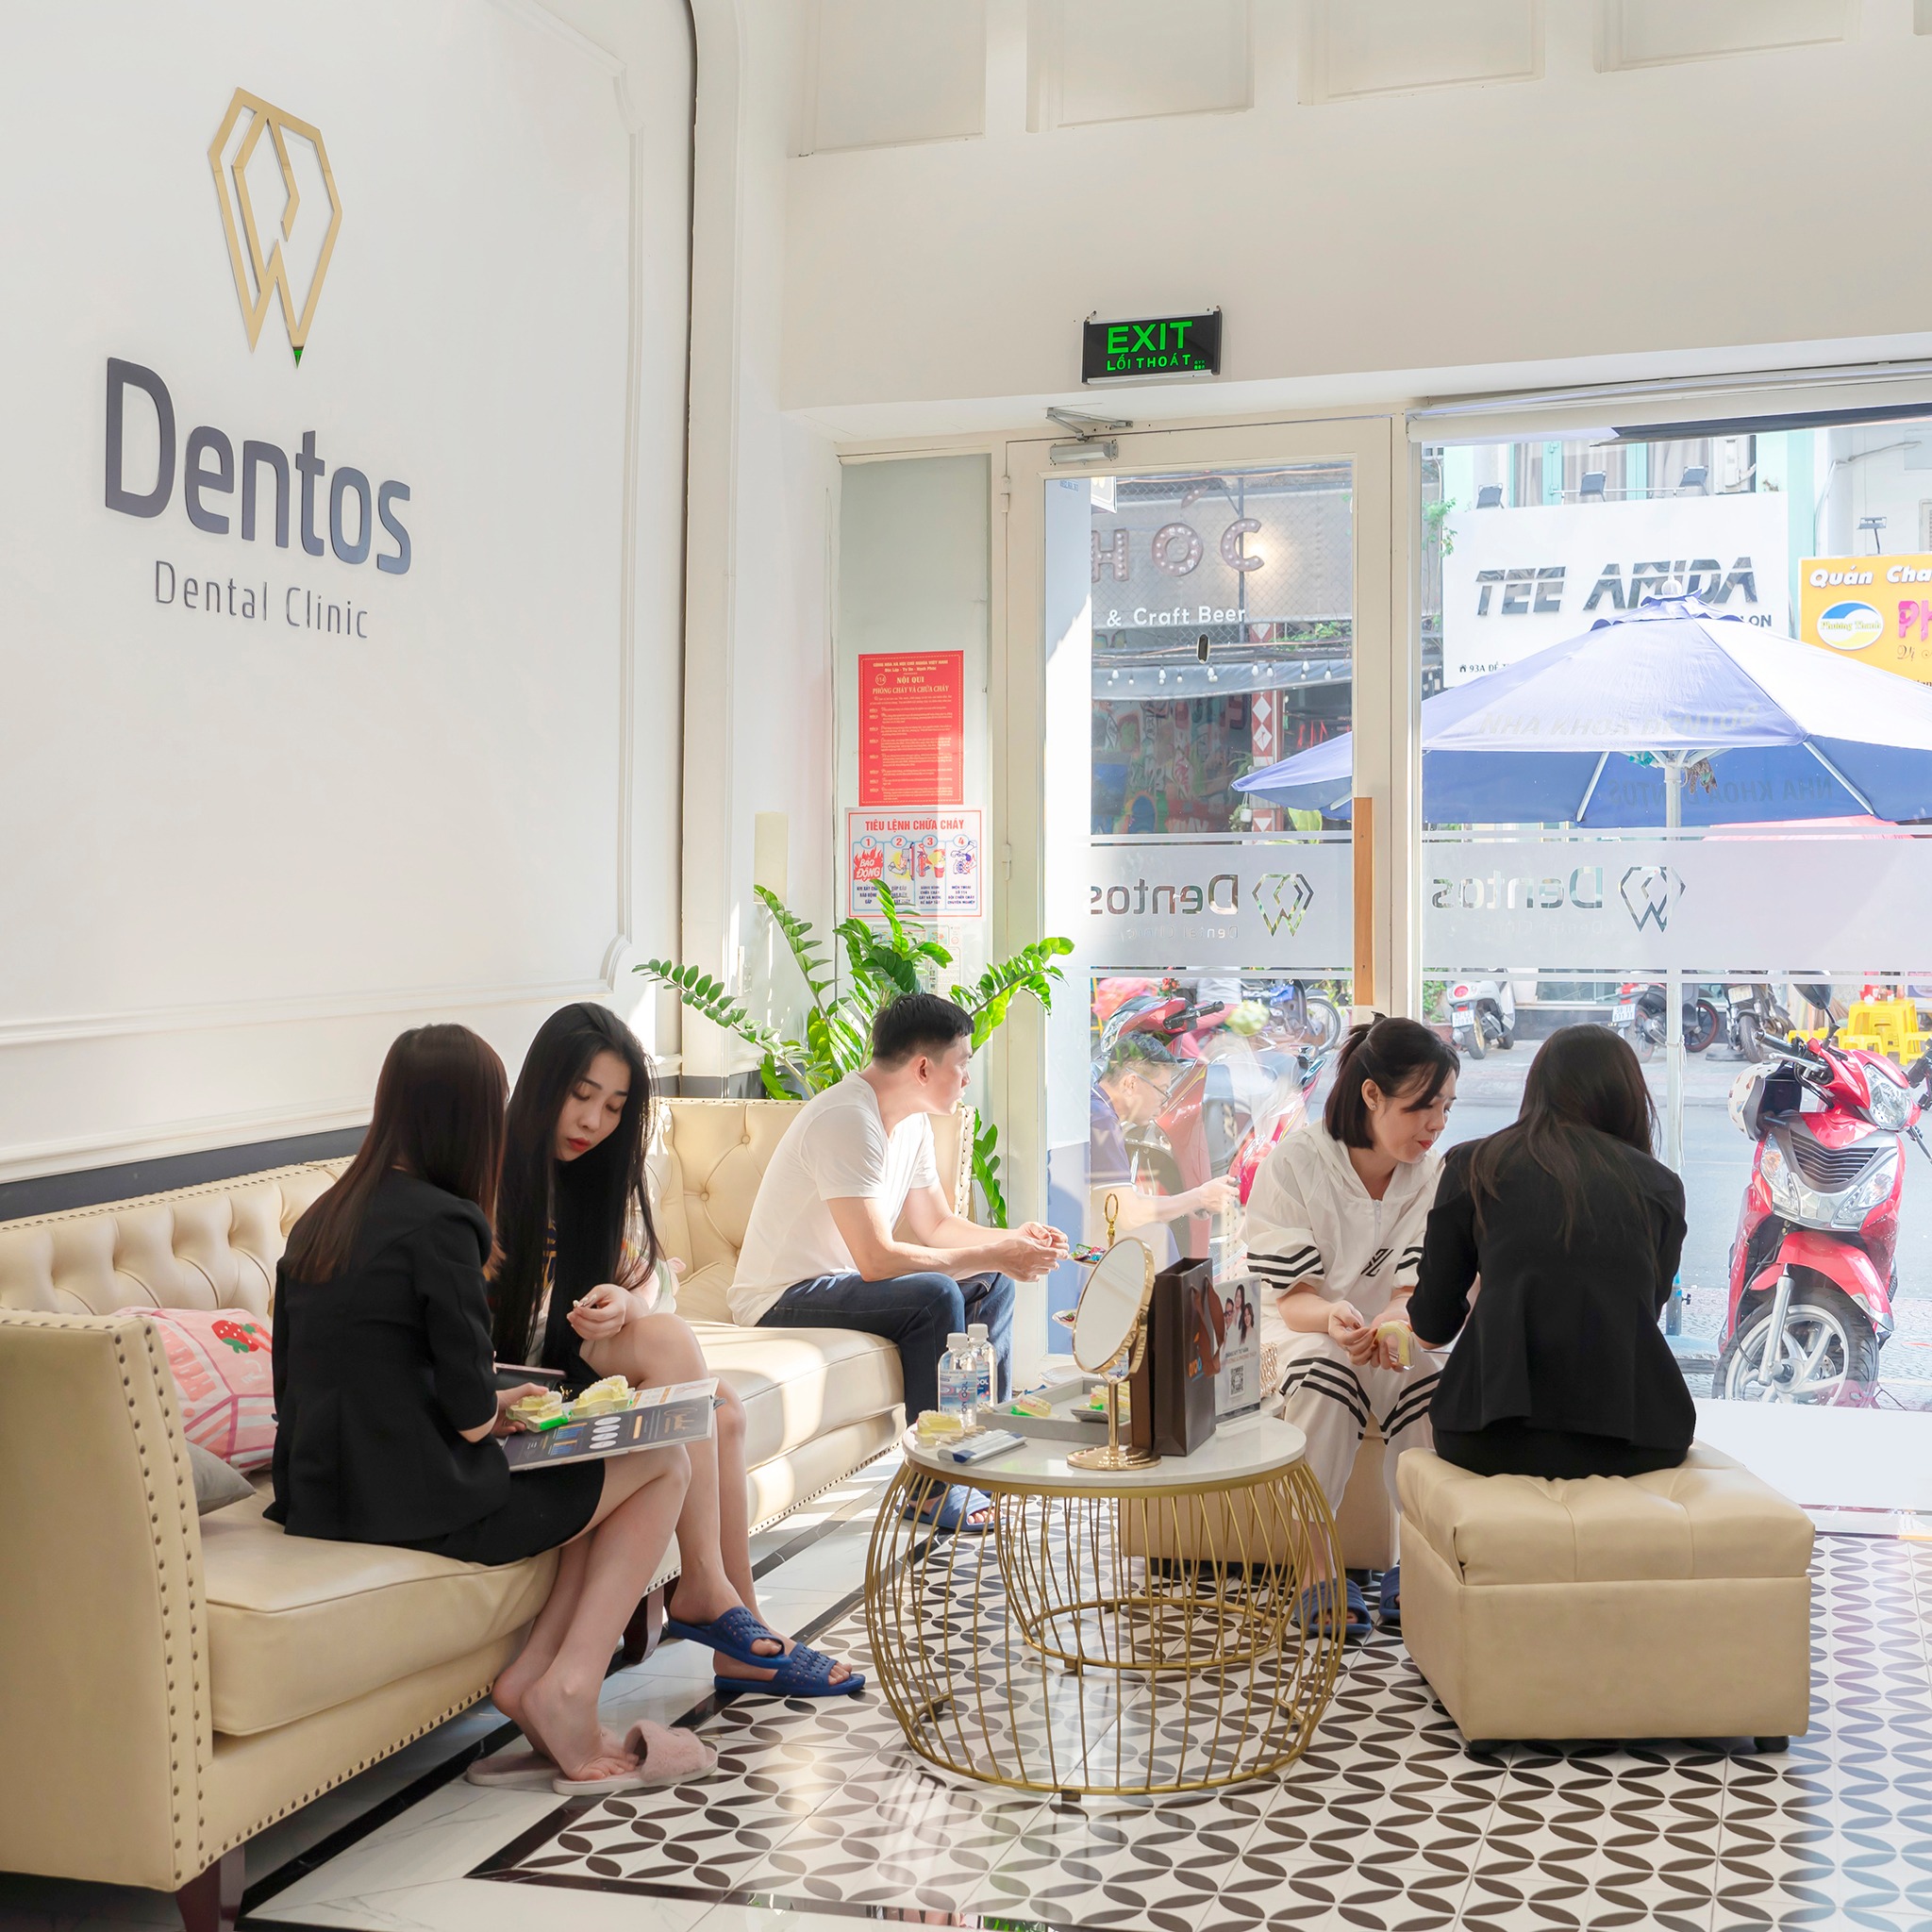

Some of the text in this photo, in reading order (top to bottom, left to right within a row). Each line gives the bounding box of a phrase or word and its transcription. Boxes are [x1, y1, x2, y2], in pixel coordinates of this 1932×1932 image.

[1108, 321, 1192, 354] EXIT
[1107, 353, 1131, 371] LỐI
[1136, 352, 1191, 369] THOÁT
[106, 357, 411, 575] Dentos
[1809, 565, 1874, 589] Quán
[155, 560, 369, 639] Dental Clinic
[1475, 566, 1566, 616] TEE
[1107, 606, 1245, 627] & Craft Beer
[1740, 614, 1772, 627] ON
[1469, 664, 1485, 673] 93A
[872, 686, 891, 694] PHÒNG
[892, 686, 908, 694] CHÁY
[865, 817, 964, 833] TIÊU LỆNH CHỮA CHÁY
[896, 838, 903, 846] 2
[856, 868, 880, 879] ĐỘNG
